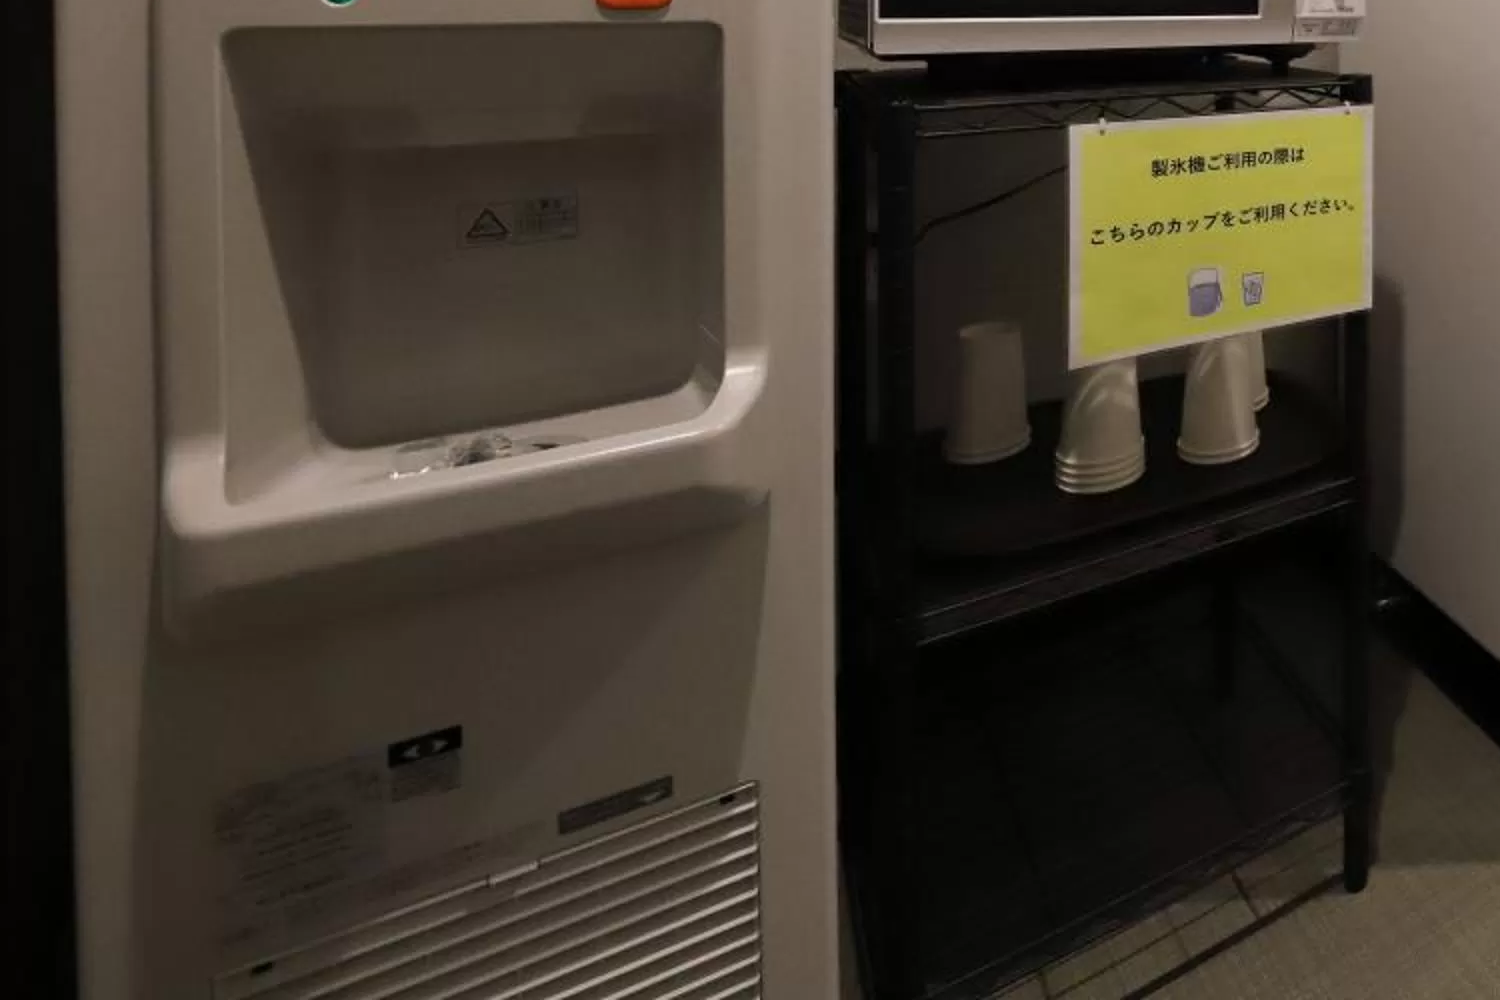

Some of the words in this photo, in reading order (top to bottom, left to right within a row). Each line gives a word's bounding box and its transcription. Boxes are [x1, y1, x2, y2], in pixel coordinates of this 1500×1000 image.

[1151, 147, 1305, 178] 製氷機ご利用の際は
[1090, 197, 1355, 246] こちらのカップをご利用ください。
